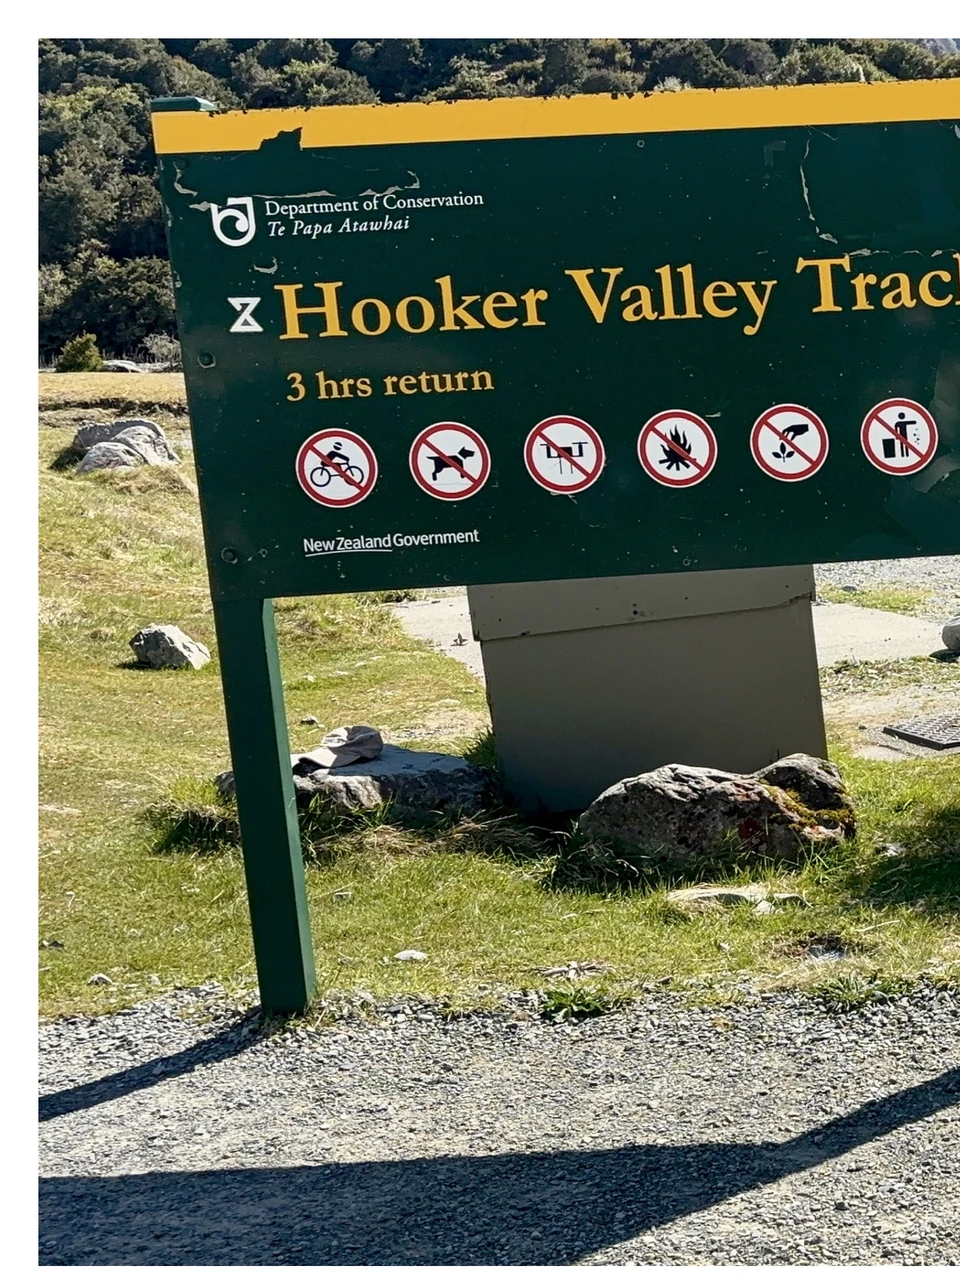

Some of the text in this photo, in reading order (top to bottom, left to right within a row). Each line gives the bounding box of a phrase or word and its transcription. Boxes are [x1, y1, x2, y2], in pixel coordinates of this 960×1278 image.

[265, 191, 485, 219] Department of Conservation
[267, 215, 410, 239] Te Papa Atawhai
[274, 275, 548, 340] Hooker
[564, 263, 778, 336] Valley
[285, 369, 495, 402] 3 hrs return
[303, 529, 480, 552] New Zealand Government
